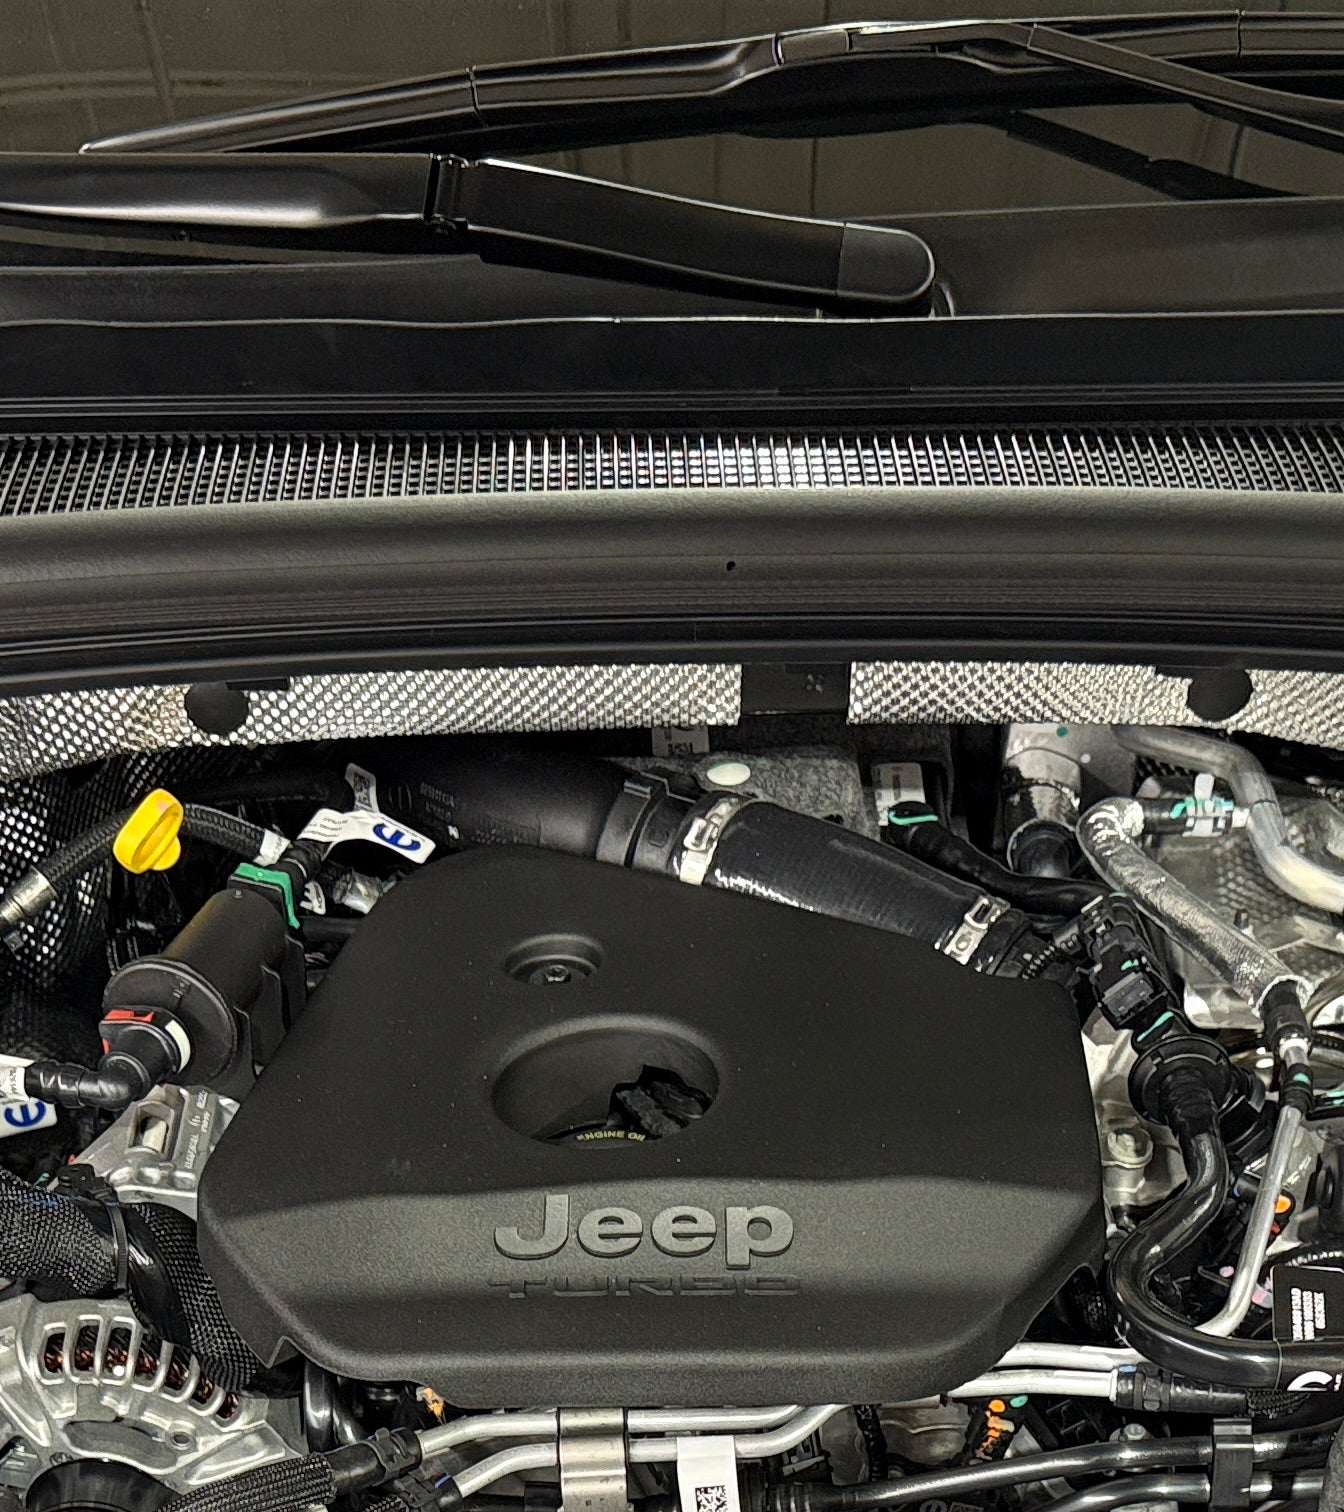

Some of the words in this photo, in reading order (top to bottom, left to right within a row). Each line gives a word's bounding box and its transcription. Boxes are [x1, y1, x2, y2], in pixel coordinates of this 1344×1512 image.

[576, 1130, 625, 1141] ENGINE
[493, 1193, 795, 1270] Jeep
[488, 1274, 802, 1299] TURBO
